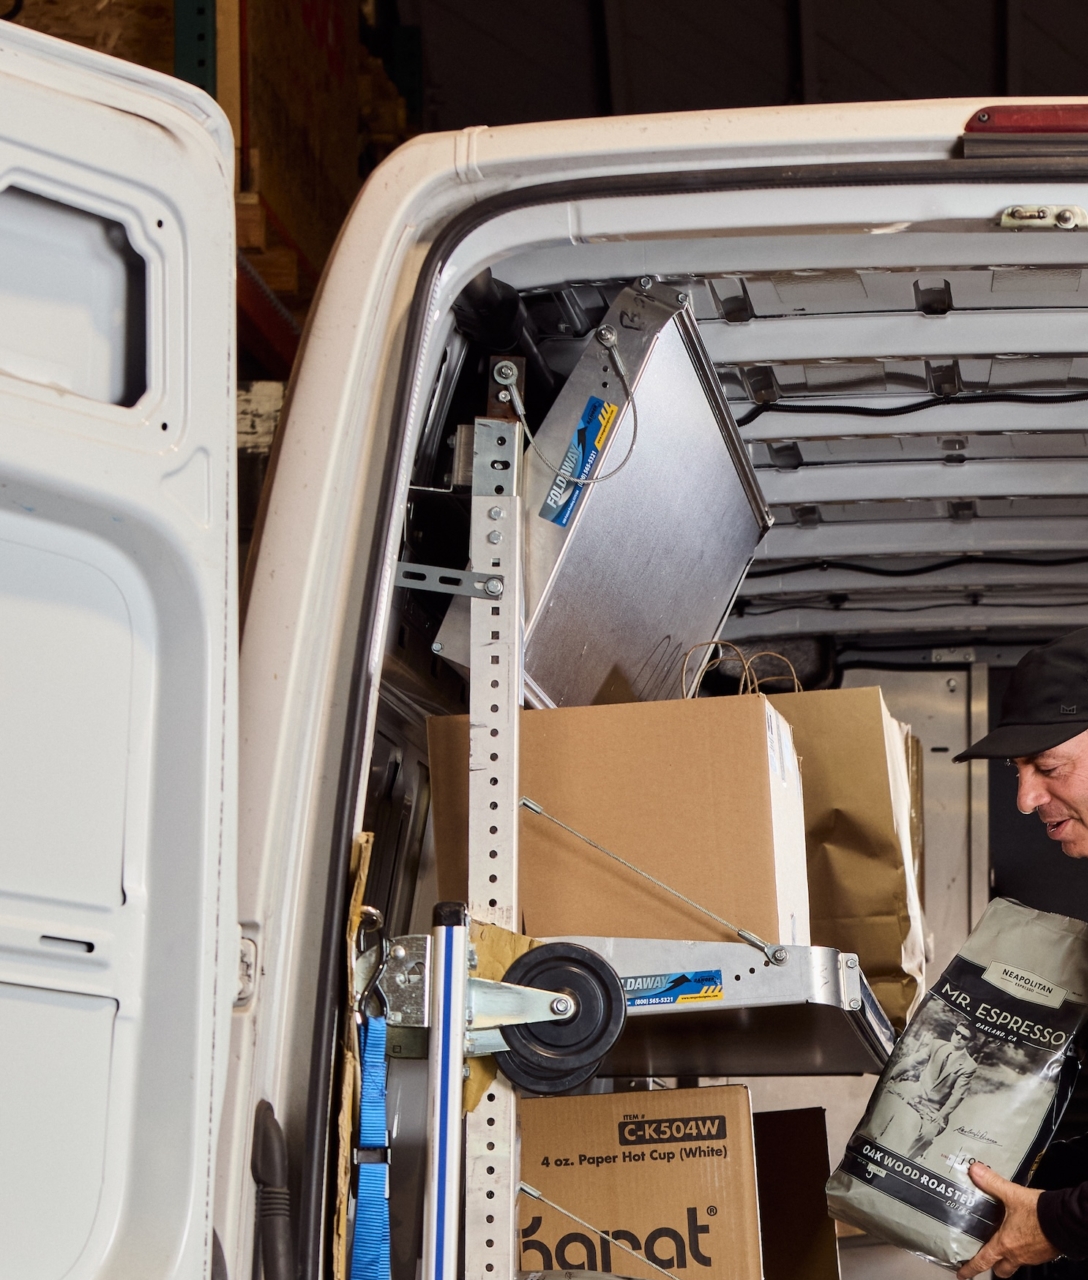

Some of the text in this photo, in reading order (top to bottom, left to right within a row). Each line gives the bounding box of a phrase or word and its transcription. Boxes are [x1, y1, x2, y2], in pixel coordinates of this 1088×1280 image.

[583, 450, 597, 476] 565-5321
[547, 445, 581, 508] FOLDAWAY
[1002, 968, 1054, 994] NEAPOLITAN
[941, 982, 1067, 1045] MR. ESPRESSO
[975, 1022, 1017, 1042] OAKLAND, CA
[624, 1119, 720, 1141] C-K504W
[541, 1145, 728, 1167] 4 oz. Paper Hot Cup (White)
[862, 1144, 976, 1207] OAK WOOD ROASTED
[946, 1200, 971, 1216] COFFEE
